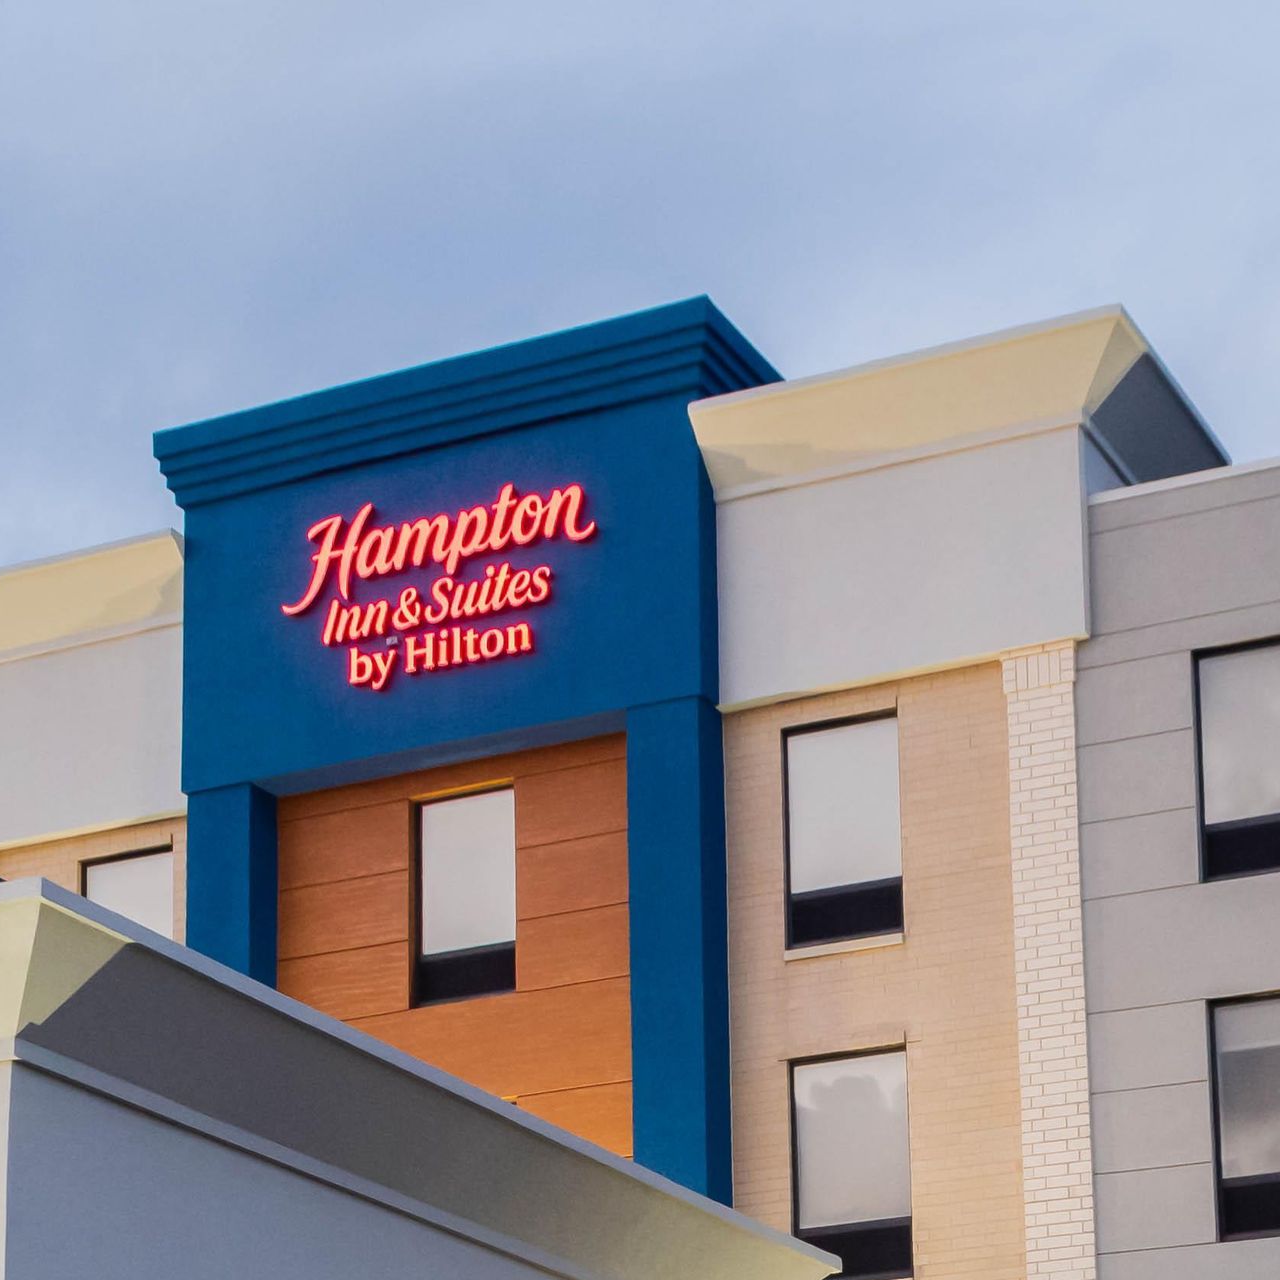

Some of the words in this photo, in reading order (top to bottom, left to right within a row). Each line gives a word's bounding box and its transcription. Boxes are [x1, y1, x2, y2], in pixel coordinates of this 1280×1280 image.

[282, 482, 596, 616] Hampton
[322, 598, 389, 646] Inn
[391, 586, 421, 632] &
[424, 562, 551, 625] Suites
[348, 647, 396, 691] by
[404, 622, 533, 674] Hilton
